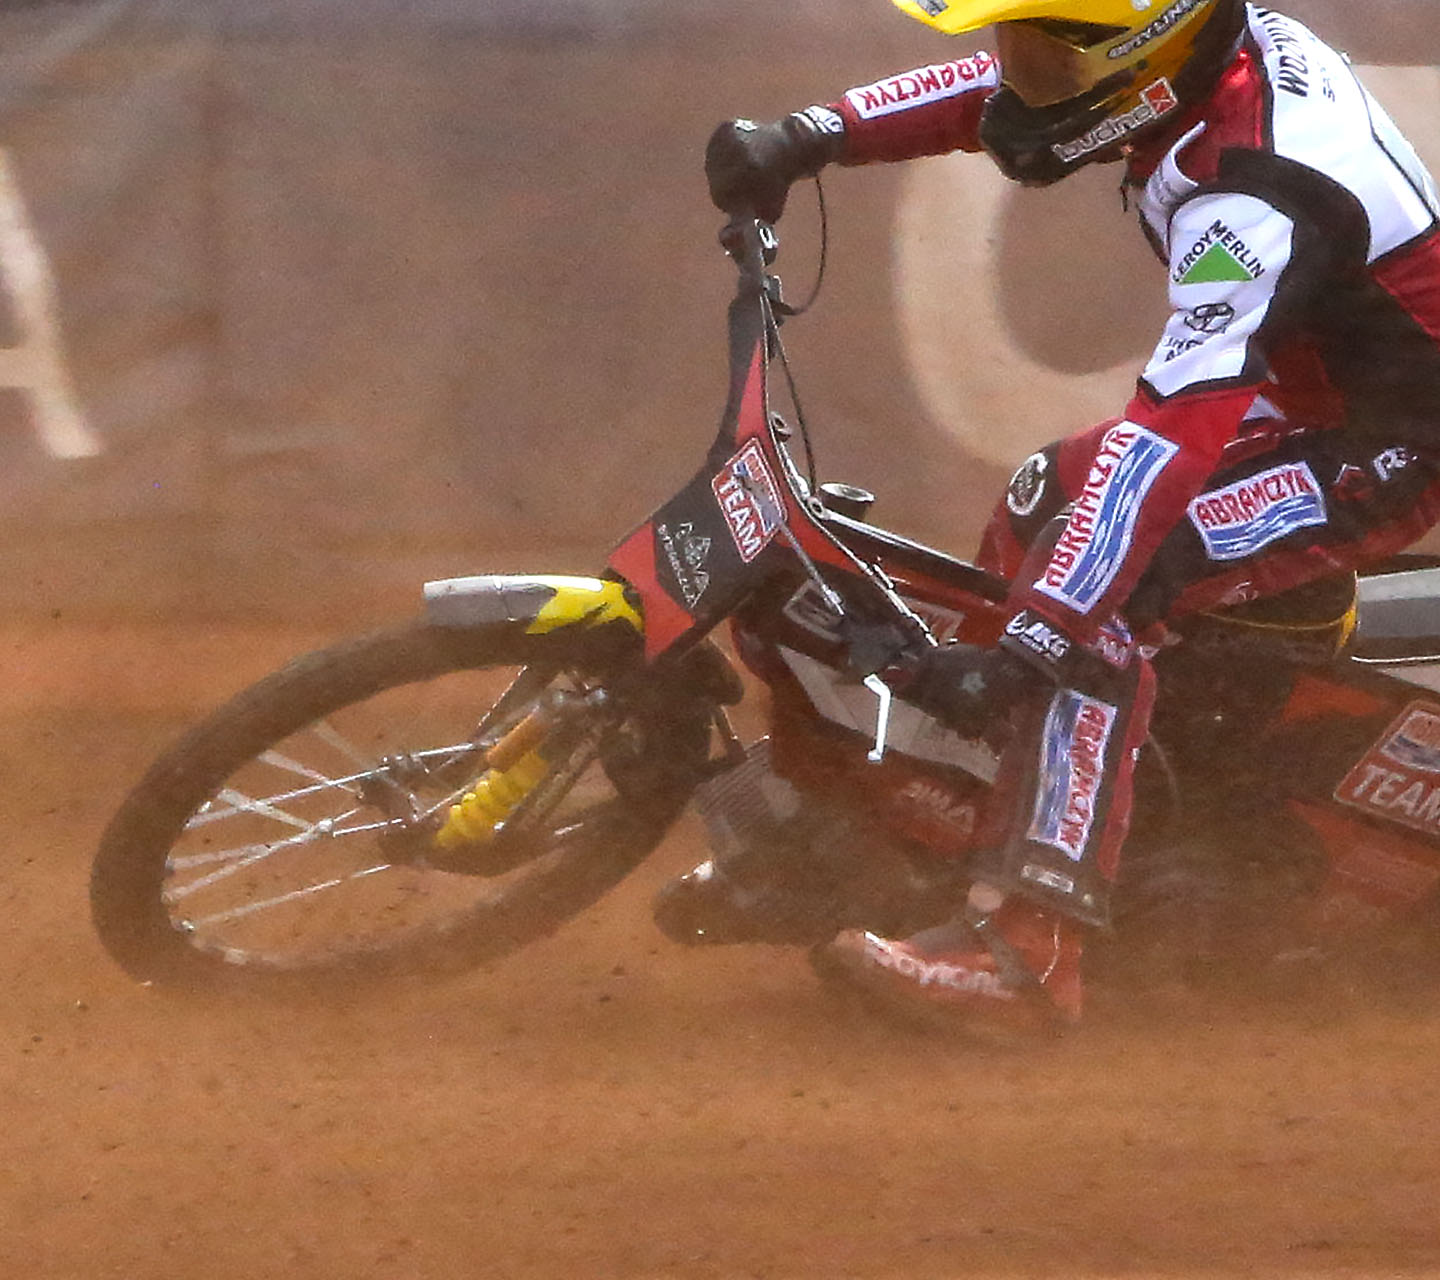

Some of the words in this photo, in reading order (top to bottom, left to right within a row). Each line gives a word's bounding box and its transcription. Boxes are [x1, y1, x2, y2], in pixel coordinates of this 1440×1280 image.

[1172, 230, 1214, 283] LEROY
[1208, 218, 1266, 279] MERLIN
[719, 477, 762, 555] TEAM
[1195, 468, 1315, 528] ABRAMCZYK
